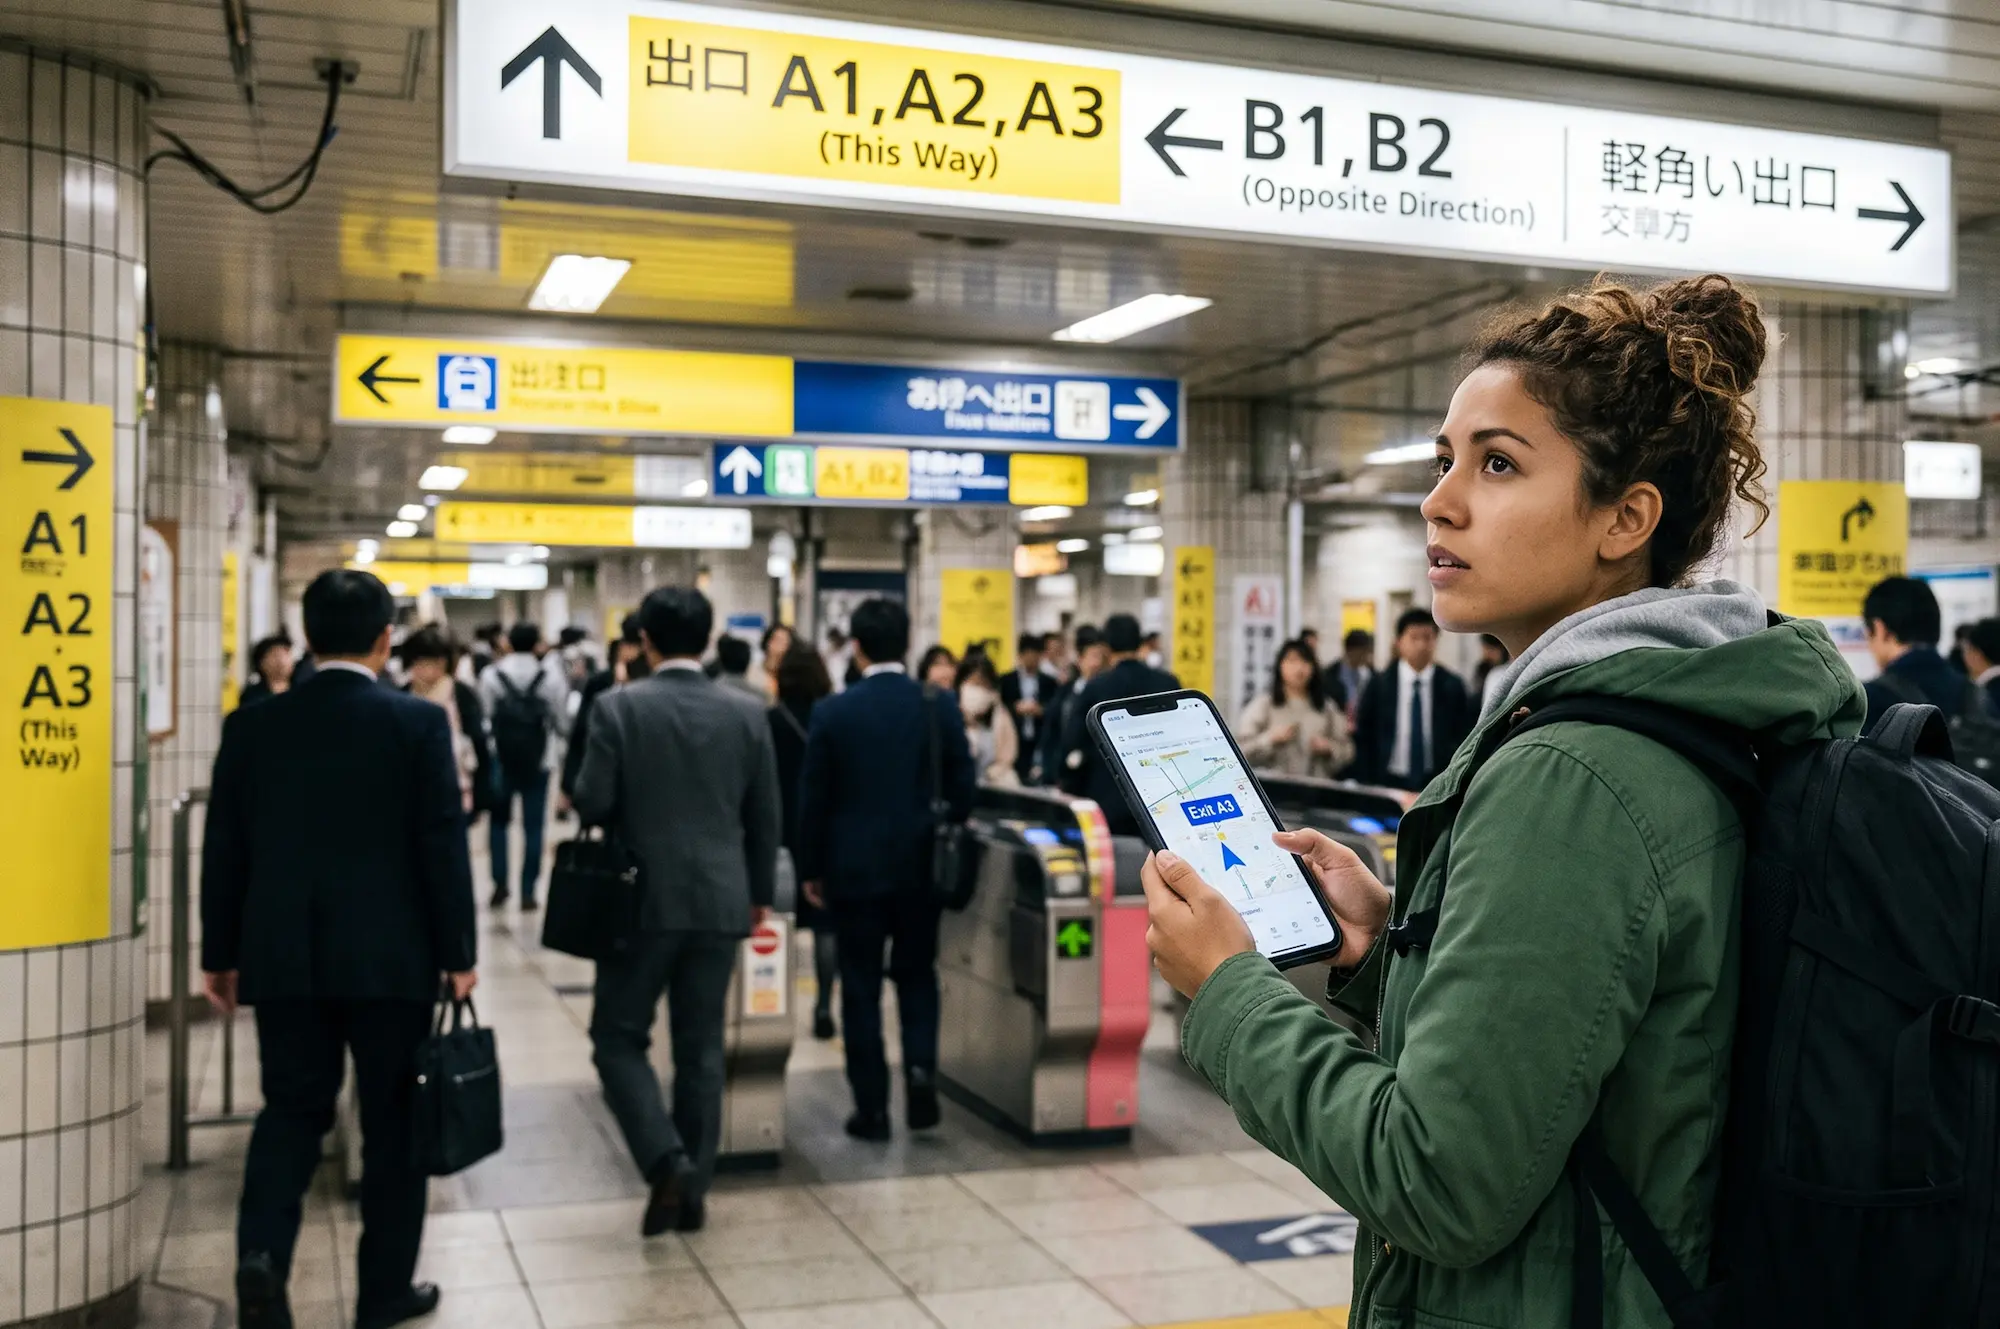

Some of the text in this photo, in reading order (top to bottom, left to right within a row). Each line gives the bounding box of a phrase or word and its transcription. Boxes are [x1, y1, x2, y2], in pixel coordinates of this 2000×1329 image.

[646, 37, 749, 96] 出口
[820, 130, 998, 181] (This Way)
[1245, 98, 1453, 180] B1,B2
[1601, 139, 1837, 213] 軽角い出口
[1243, 174, 1536, 232] (Opposite Direction)
[21, 510, 87, 556] A1
[21, 592, 92, 636] A2
[21, 664, 92, 709] A3
[20, 719, 78, 744] (This
[20, 747, 81, 773] Way)
[1187, 799, 1235, 819] Exit A3
